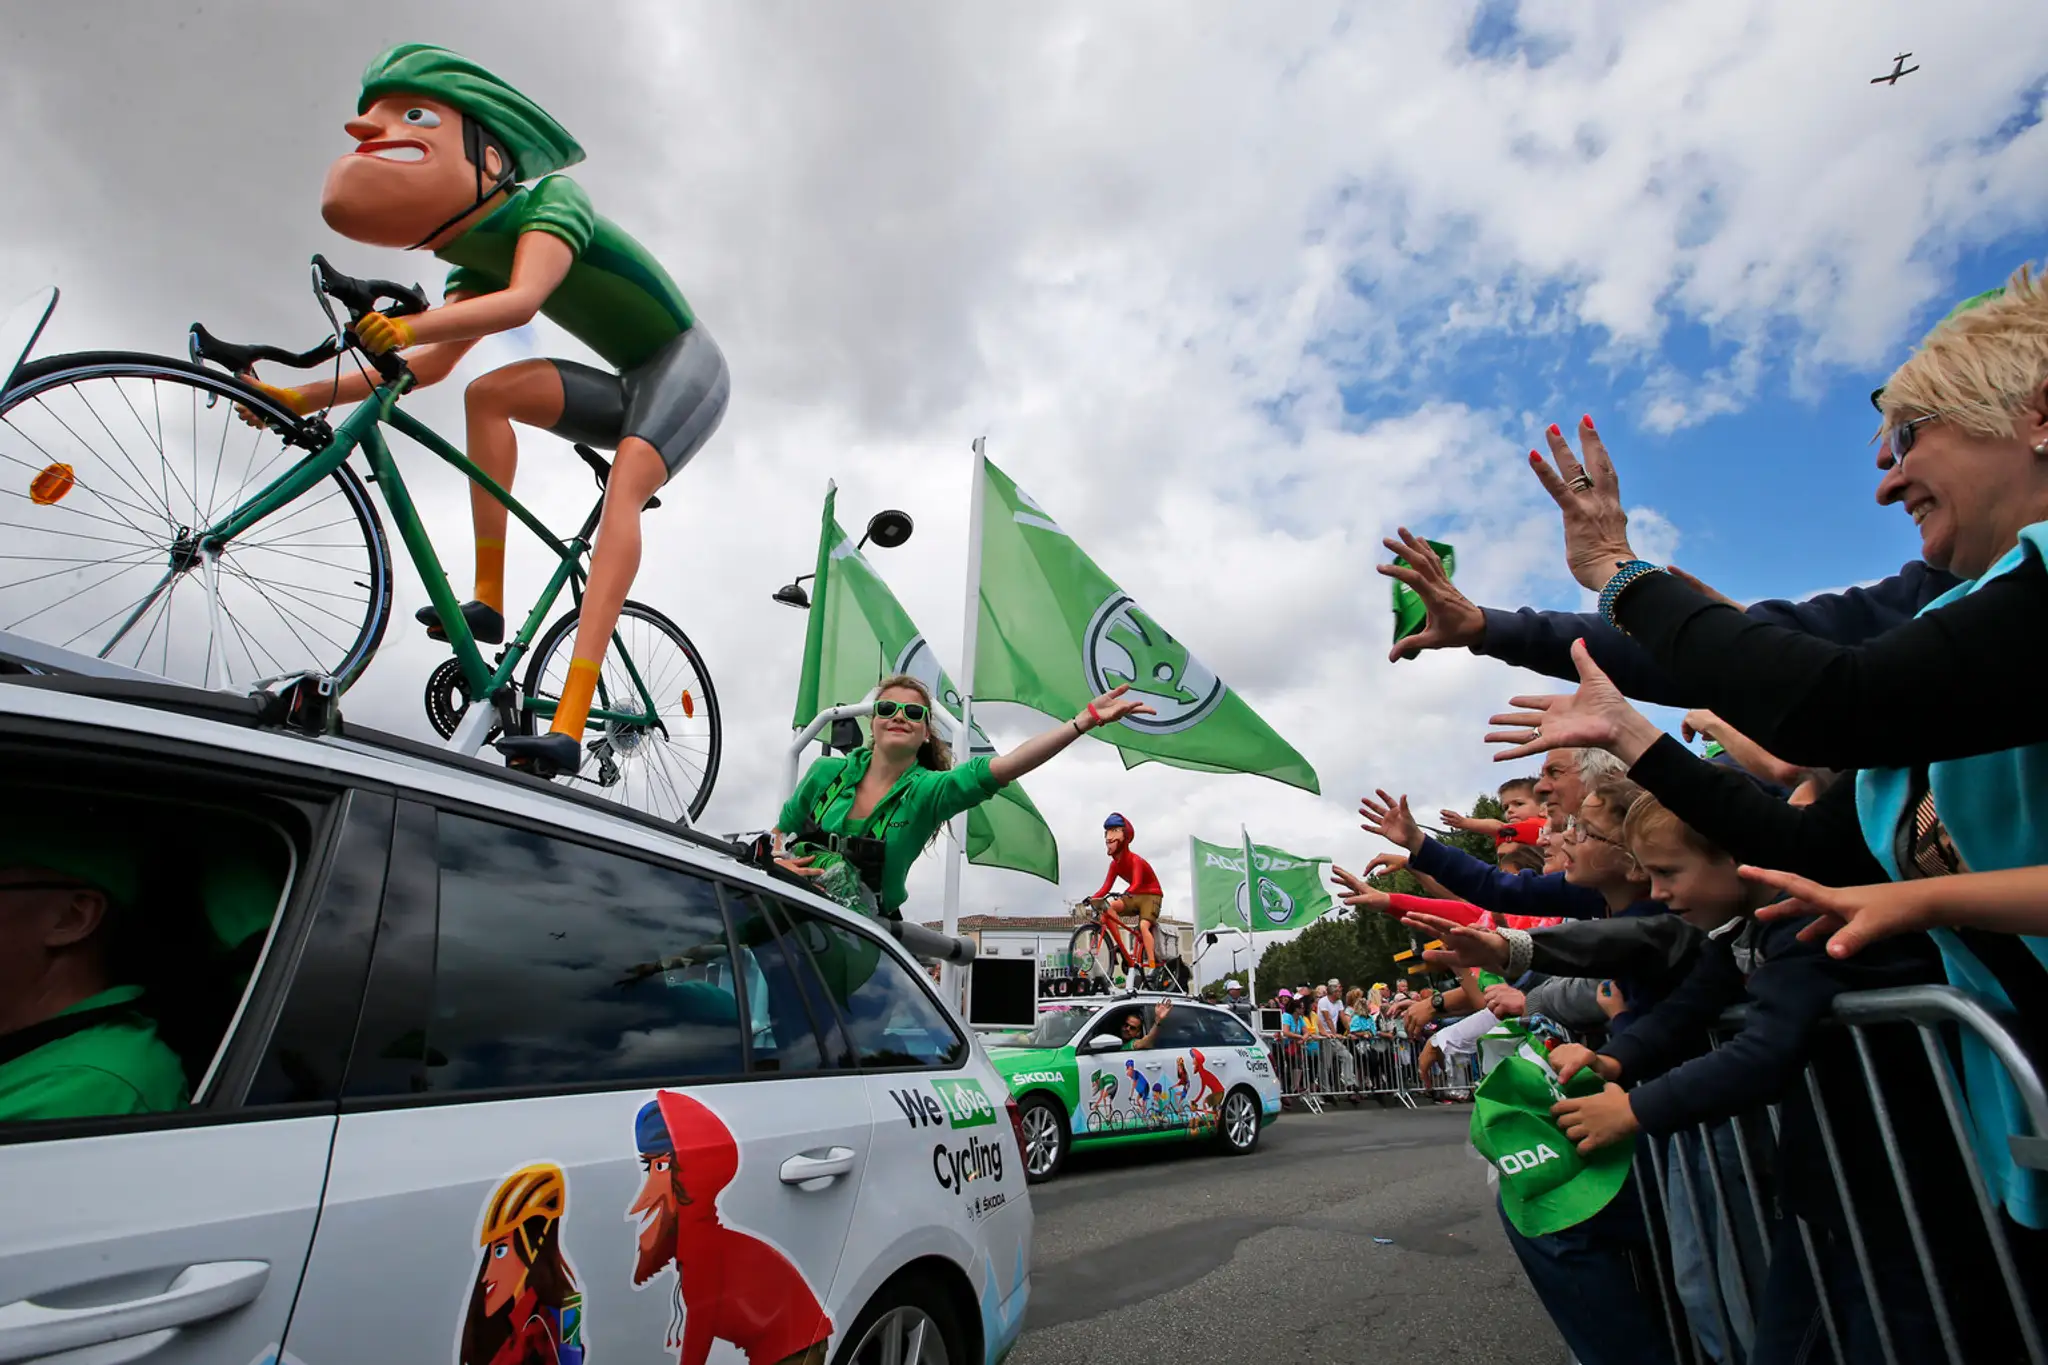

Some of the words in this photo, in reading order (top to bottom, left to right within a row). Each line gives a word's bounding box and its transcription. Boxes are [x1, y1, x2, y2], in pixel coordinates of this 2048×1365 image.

[1013, 1071, 1065, 1085] ŠKODA
[1246, 1059, 1268, 1072] Cycling
[889, 1088, 944, 1128] We
[938, 1081, 992, 1121] Love
[933, 1136, 1003, 1195] Cycling
[1498, 1142, 1560, 1175] ODA
[983, 1192, 1006, 1211] ŠKODA
